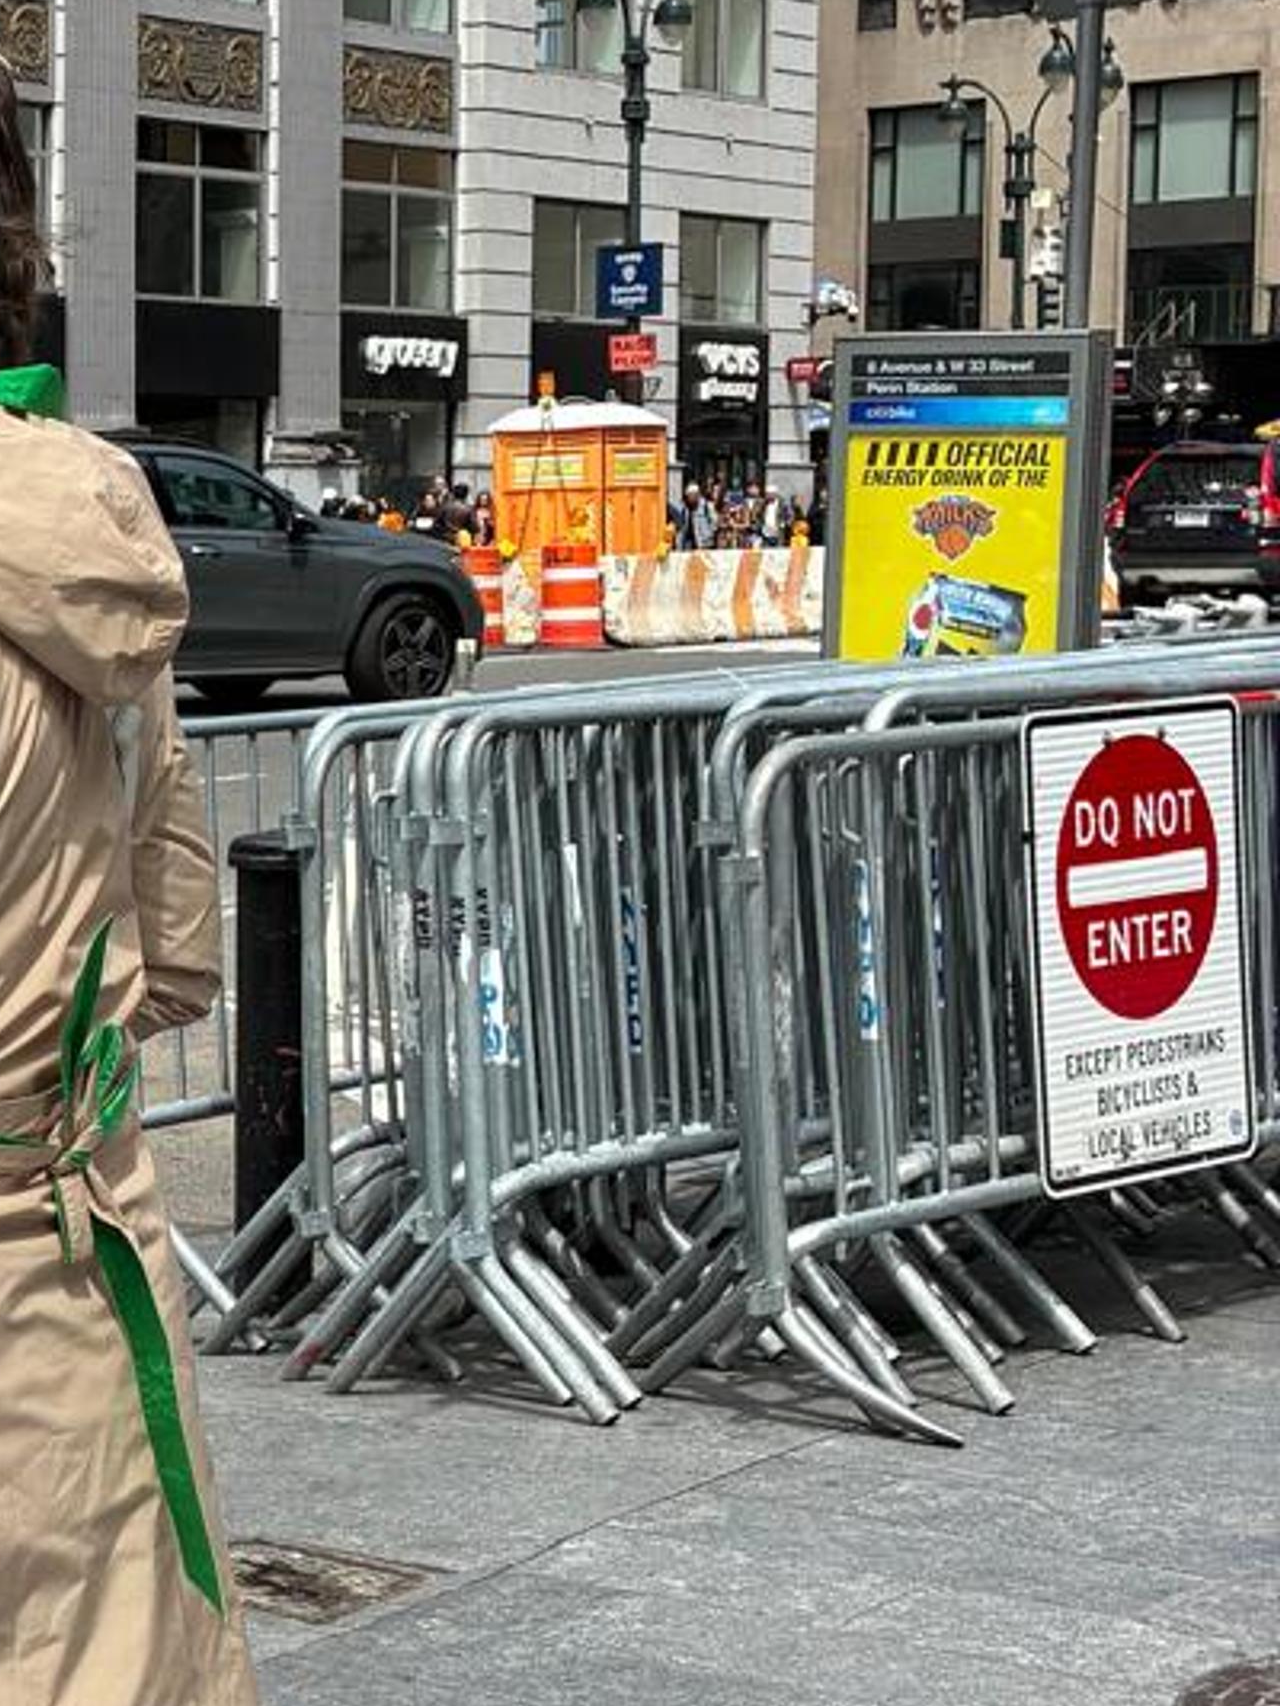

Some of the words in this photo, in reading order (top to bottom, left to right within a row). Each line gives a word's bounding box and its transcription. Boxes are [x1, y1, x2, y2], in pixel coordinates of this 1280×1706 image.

[866, 381, 904, 394] Penn
[906, 381, 959, 394] Station
[880, 359, 932, 373] Avenue
[934, 359, 947, 373] &
[950, 359, 965, 373] W
[989, 357, 1035, 373] Street
[861, 469, 929, 487] ENERGY
[931, 469, 986, 487] DRINK
[988, 468, 1013, 486] OF
[1016, 467, 1049, 486] THE
[946, 441, 1051, 467] OFFICIAL
[1075, 796, 1120, 847] DO
[1133, 787, 1196, 839] NOT
[1087, 909, 1194, 970] ENTER
[1066, 1045, 1123, 1080] EXCEPT
[1127, 1027, 1226, 1070] PEDESTRIANS
[1097, 1072, 1182, 1116] BICYCLISTS
[1187, 1070, 1199, 1097] &
[1090, 1125, 1137, 1159] LOCAL
[1142, 1109, 1211, 1147] VEHICLES
